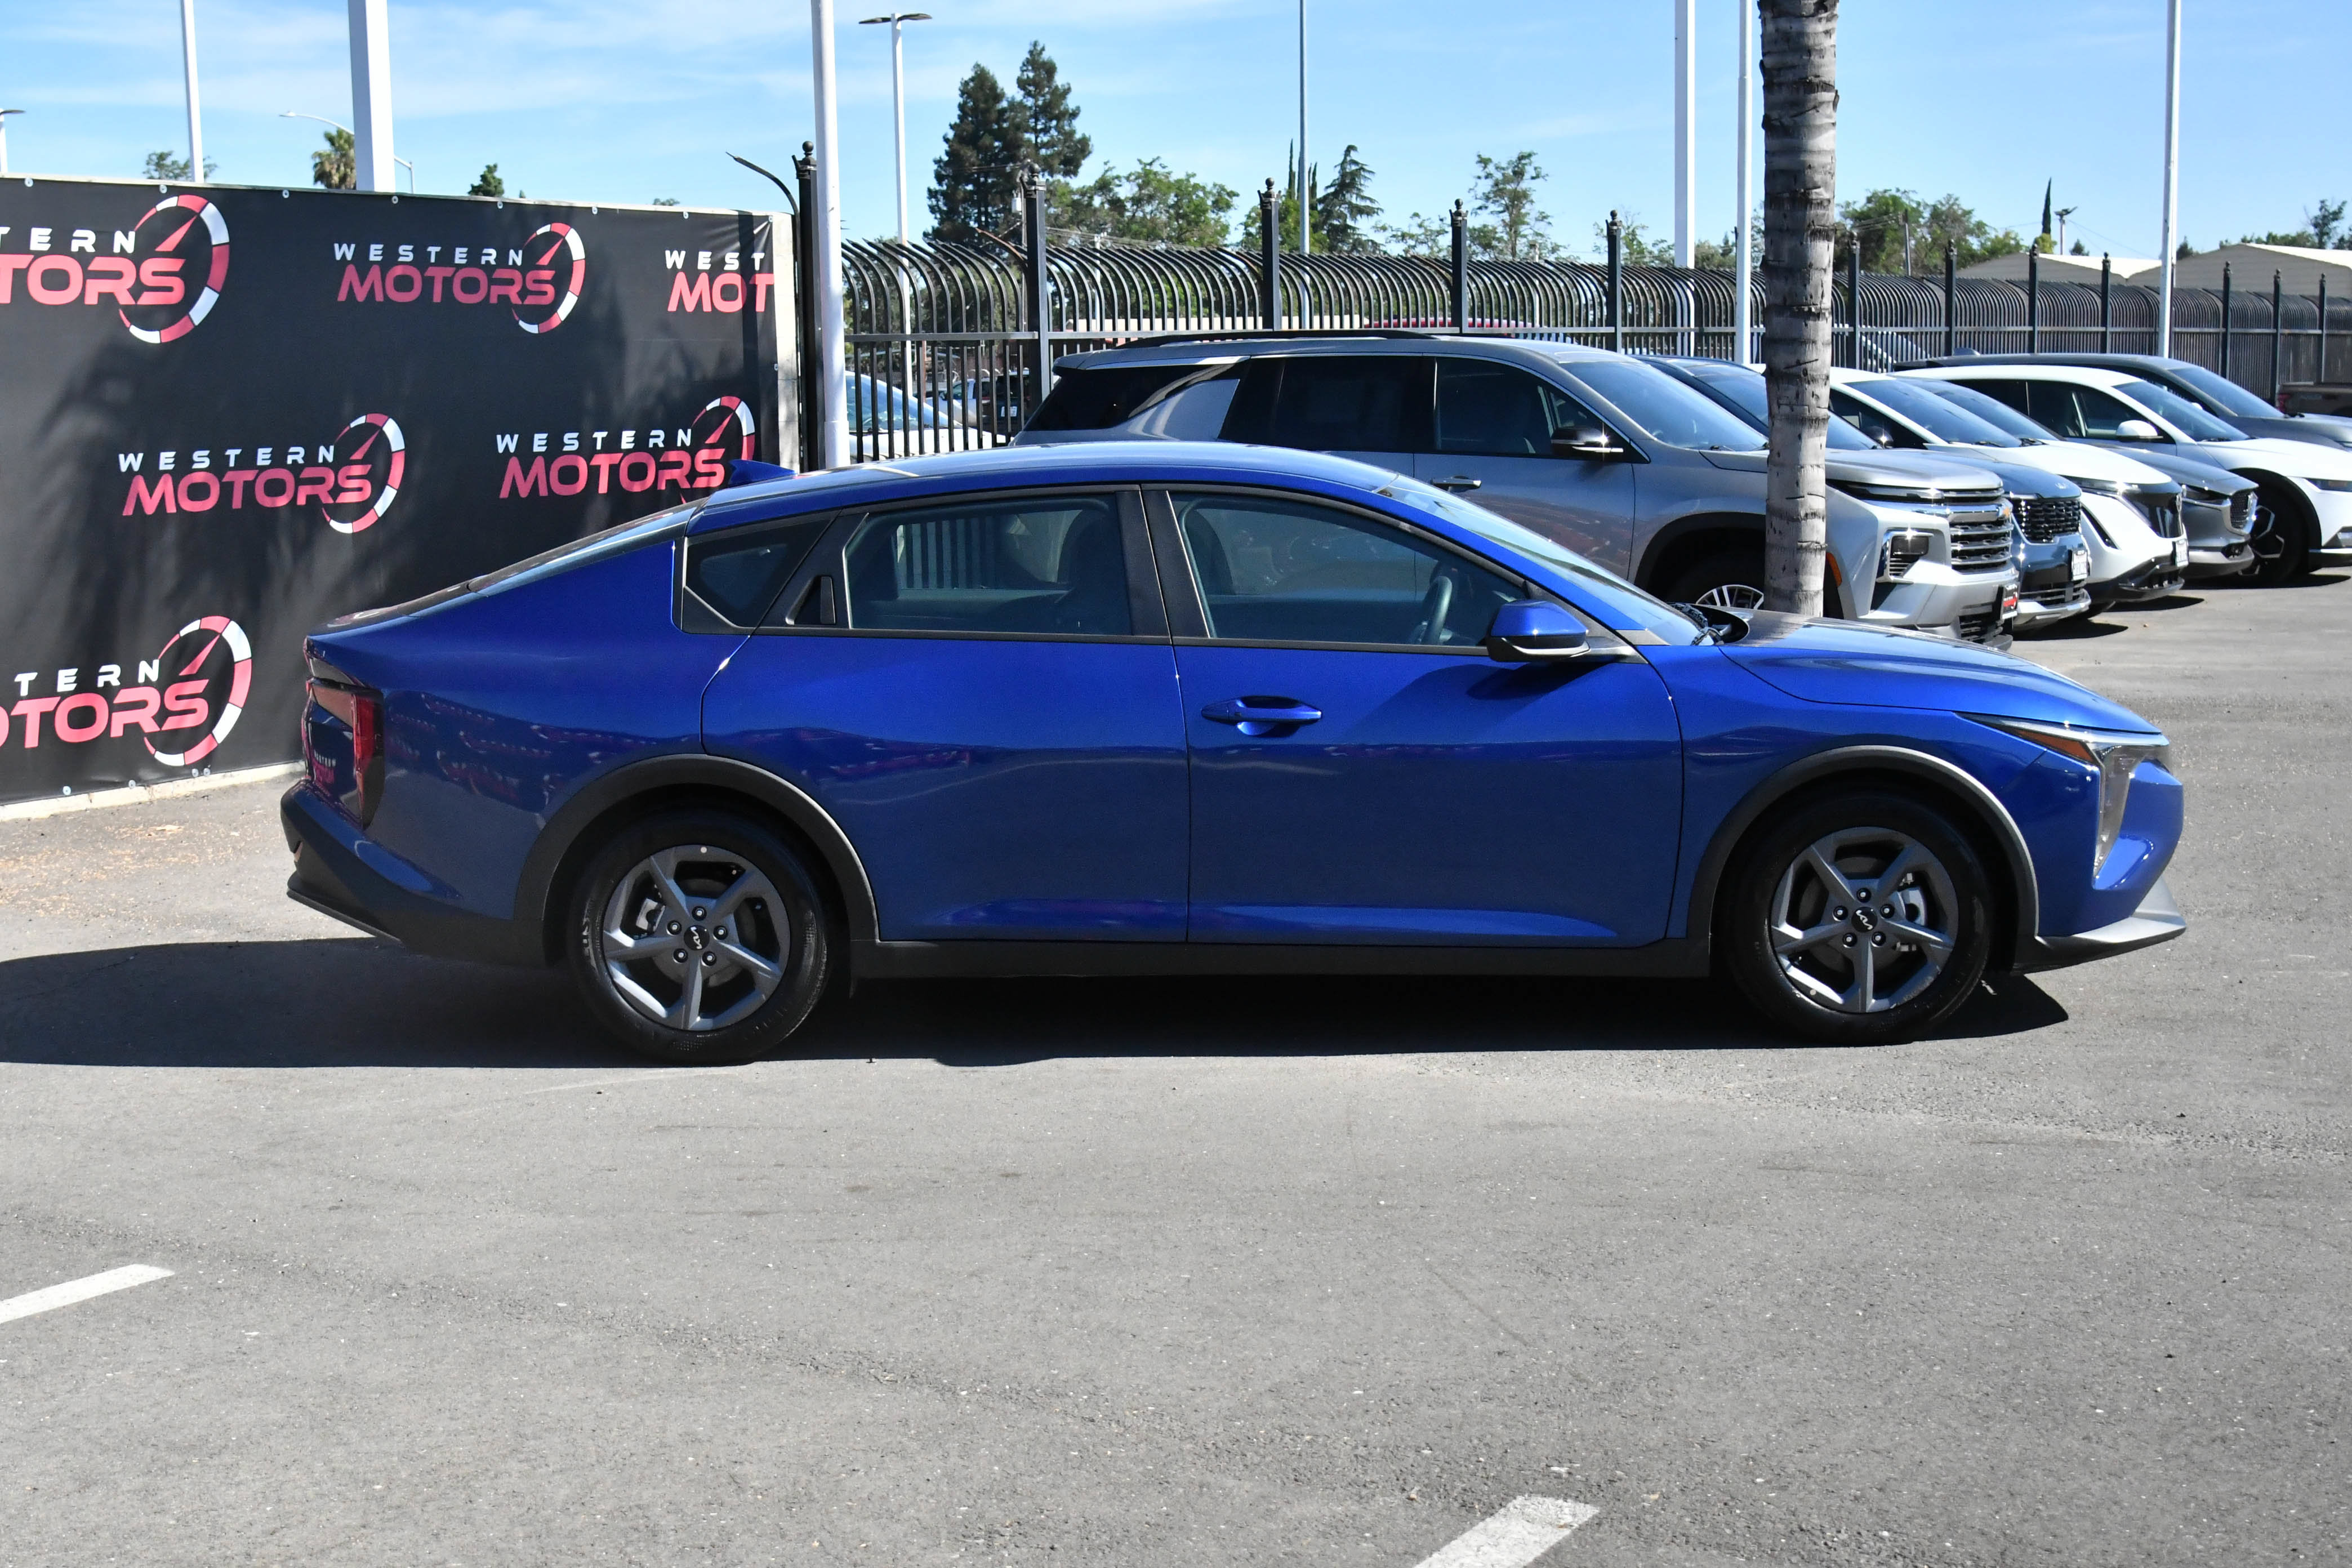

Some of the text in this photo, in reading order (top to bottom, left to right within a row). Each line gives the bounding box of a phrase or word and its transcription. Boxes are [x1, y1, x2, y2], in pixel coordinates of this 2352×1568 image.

[334, 243, 523, 266] WESTERN
[665, 250, 765, 271] WEST
[0, 253, 186, 306] TORS
[337, 264, 556, 305] MOTORS
[667, 271, 775, 314] MOT
[118, 445, 335, 473] WESTERN
[496, 429, 692, 454] WESTERN
[122, 464, 372, 516] MOTORS
[500, 448, 725, 499] MOTORS
[14, 658, 160, 697] TERN
[0, 679, 210, 749] TORS
